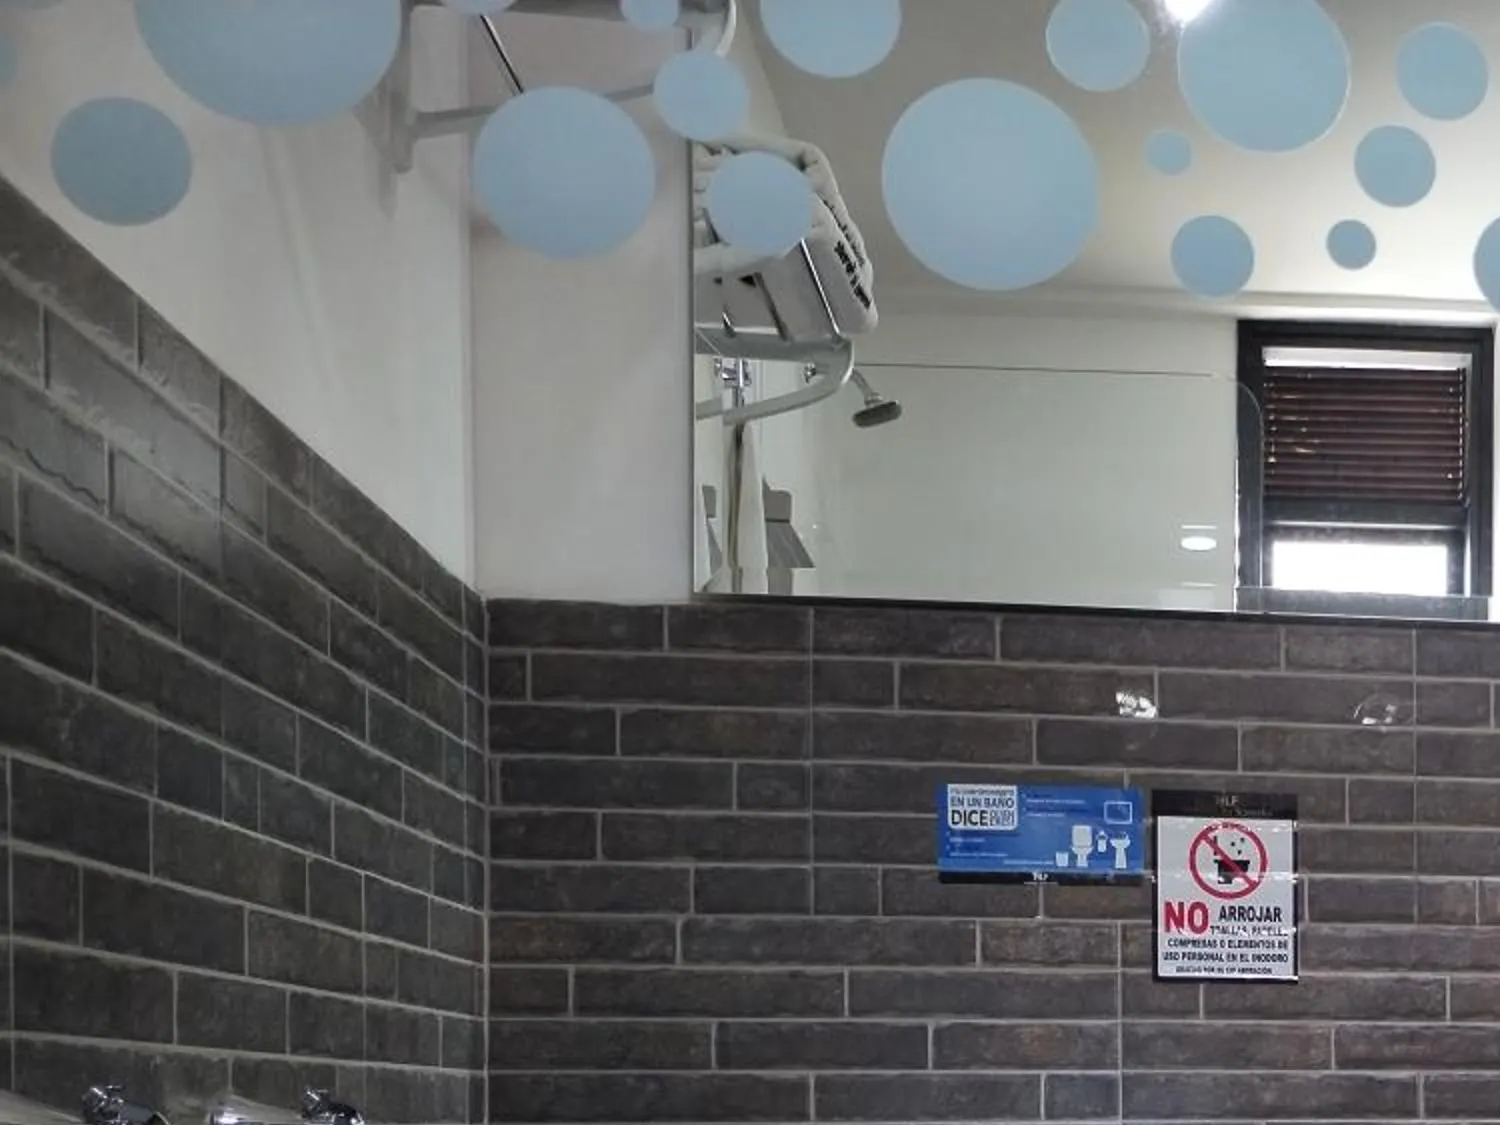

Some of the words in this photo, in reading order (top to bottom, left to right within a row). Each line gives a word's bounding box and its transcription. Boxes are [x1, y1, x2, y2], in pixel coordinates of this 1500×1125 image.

[951, 809, 988, 827] DICE
[1163, 901, 1209, 934] NO
[1218, 905, 1282, 922] ARROJAR
[1167, 938, 1218, 948] COMPRESAS
[1227, 939, 1276, 949] ELEMENTOS
[1163, 951, 1181, 961] USO
[1181, 952, 1225, 962] PERSONAL
[1251, 953, 1289, 963] INODORO
